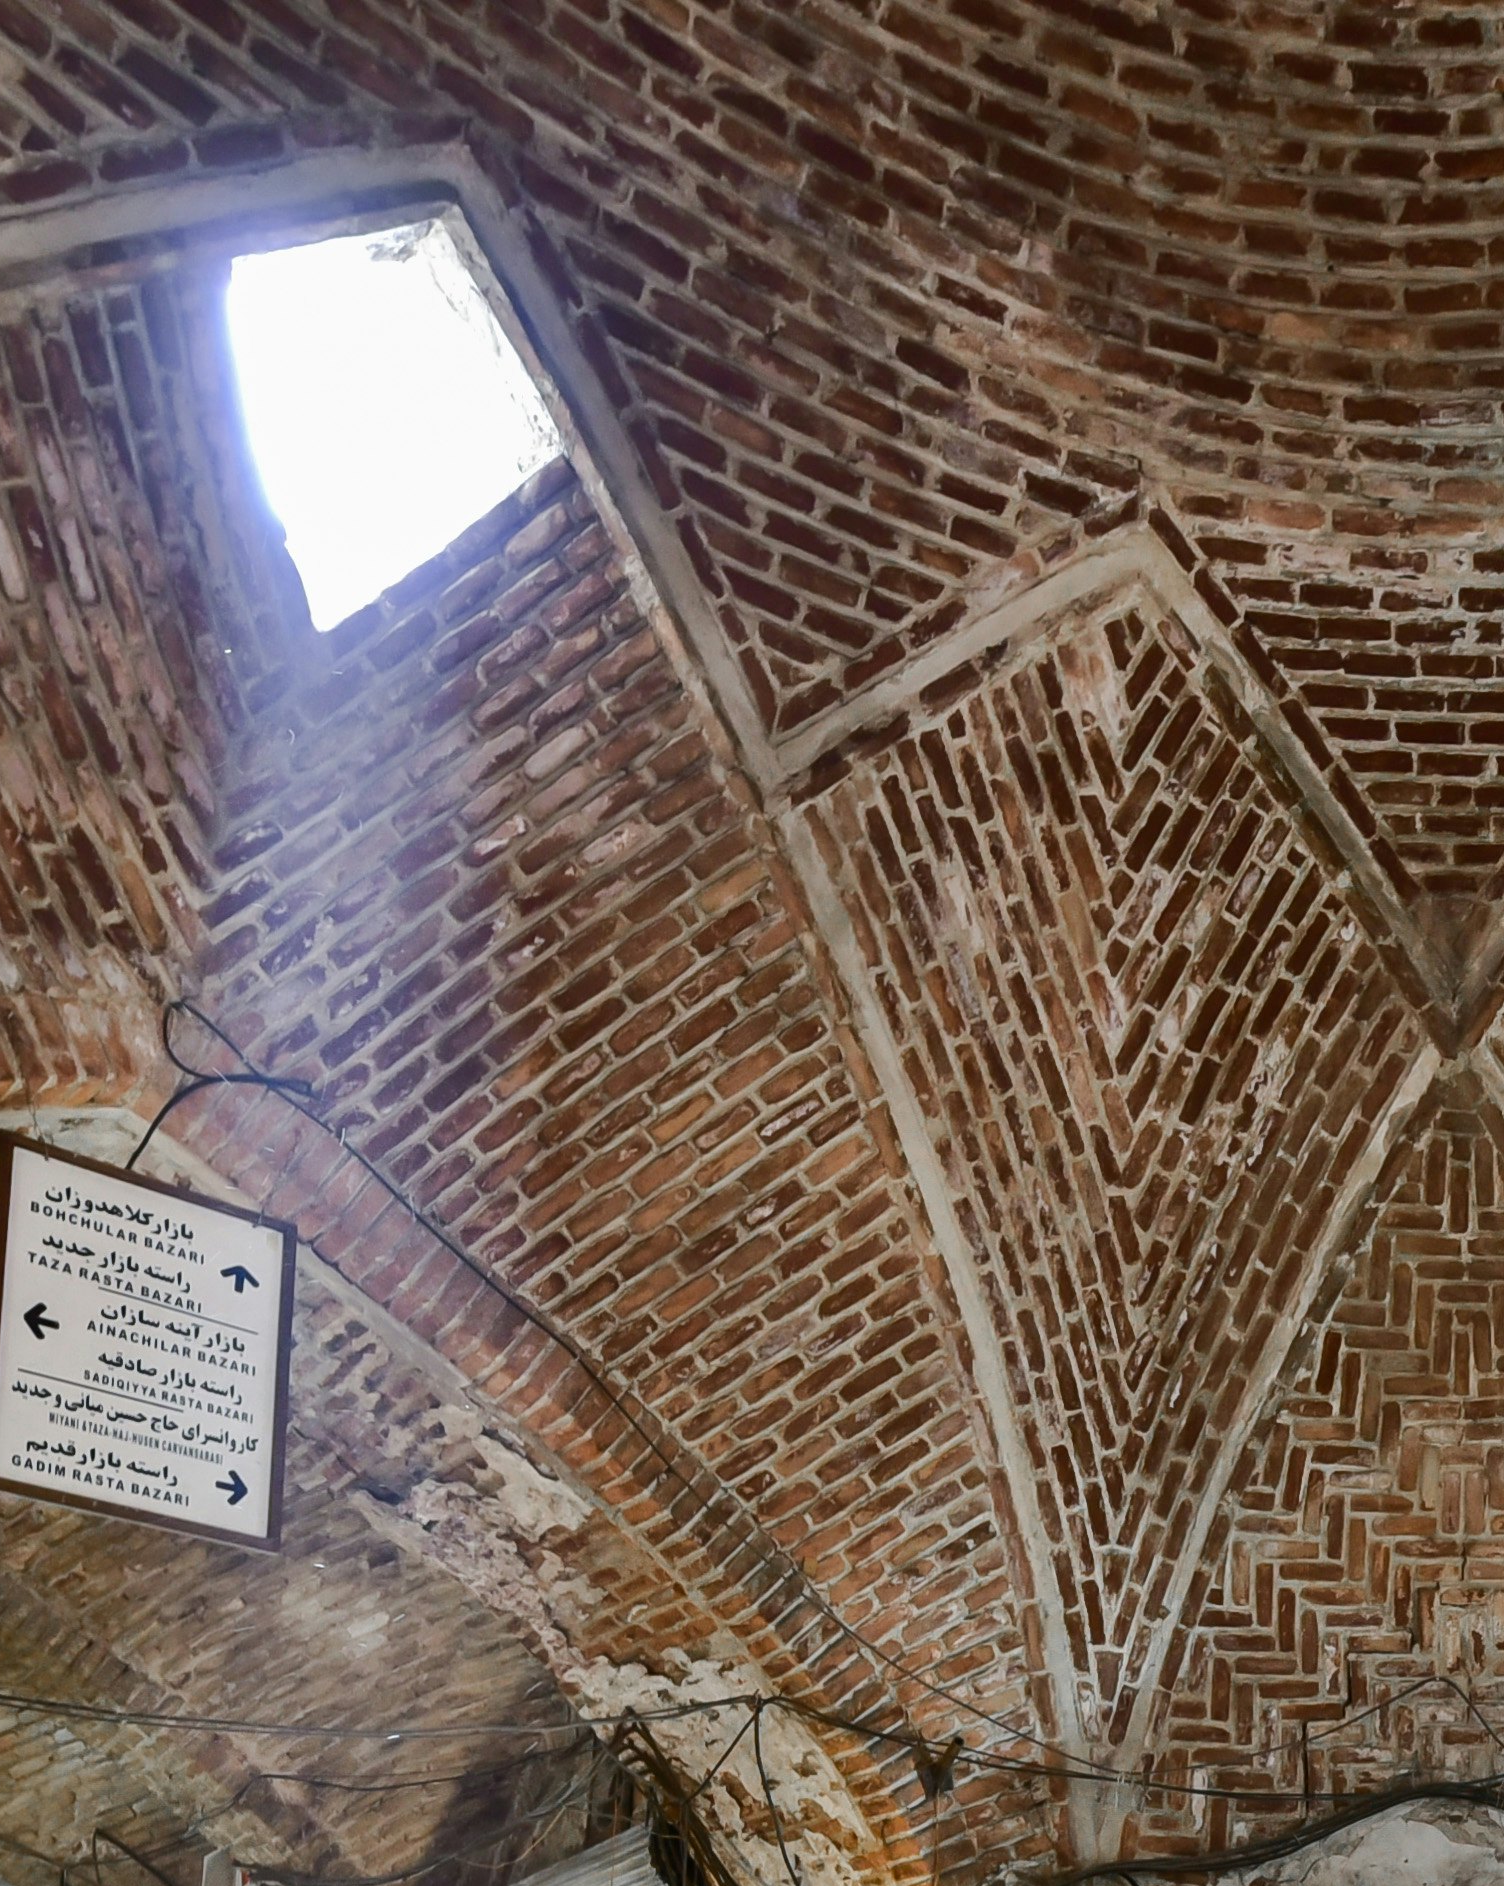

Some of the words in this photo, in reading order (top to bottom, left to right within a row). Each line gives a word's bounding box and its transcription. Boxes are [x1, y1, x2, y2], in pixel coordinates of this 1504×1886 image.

[30, 1201, 137, 1243] BOHCHULAR
[144, 1236, 205, 1265] BAZARI
[152, 1219, 194, 1247] بازار
[42, 1234, 95, 1264] جدید
[98, 1251, 139, 1278] بازار
[28, 1251, 72, 1275] TAZA
[79, 1268, 133, 1293] RASTA
[140, 1286, 202, 1313] BAZARI
[143, 1265, 191, 1293] راسته
[100, 1304, 160, 1328] سازان
[164, 1320, 204, 1342] آینه
[203, 1332, 246, 1356] بازار
[87, 1320, 192, 1358] AINACHILAR
[197, 1351, 257, 1377] BAZARI
[98, 1351, 158, 1377] صادقیه
[11, 1379, 52, 1405] جدید
[159, 1368, 197, 1392] بازار
[199, 1380, 243, 1406] راسته
[55, 1394, 63, 1408] و
[64, 1393, 104, 1417] میانی
[83, 1369, 156, 1398] SADIQIYYA
[161, 1390, 203, 1411] RASTA
[207, 1403, 254, 1424] BAZARI
[49, 1412, 80, 1430] MIYANI
[106, 1405, 147, 1424] حسین
[150, 1415, 179, 1432] حاج
[26, 1438, 76, 1462] قدیم
[181, 1424, 259, 1454] کاروانسرای
[76, 1448, 121, 1473] بازار
[126, 1461, 178, 1486] راسته
[11, 1454, 66, 1477] GADIM
[72, 1469, 125, 1492] RASTA
[131, 1483, 190, 1507] BAZARI
